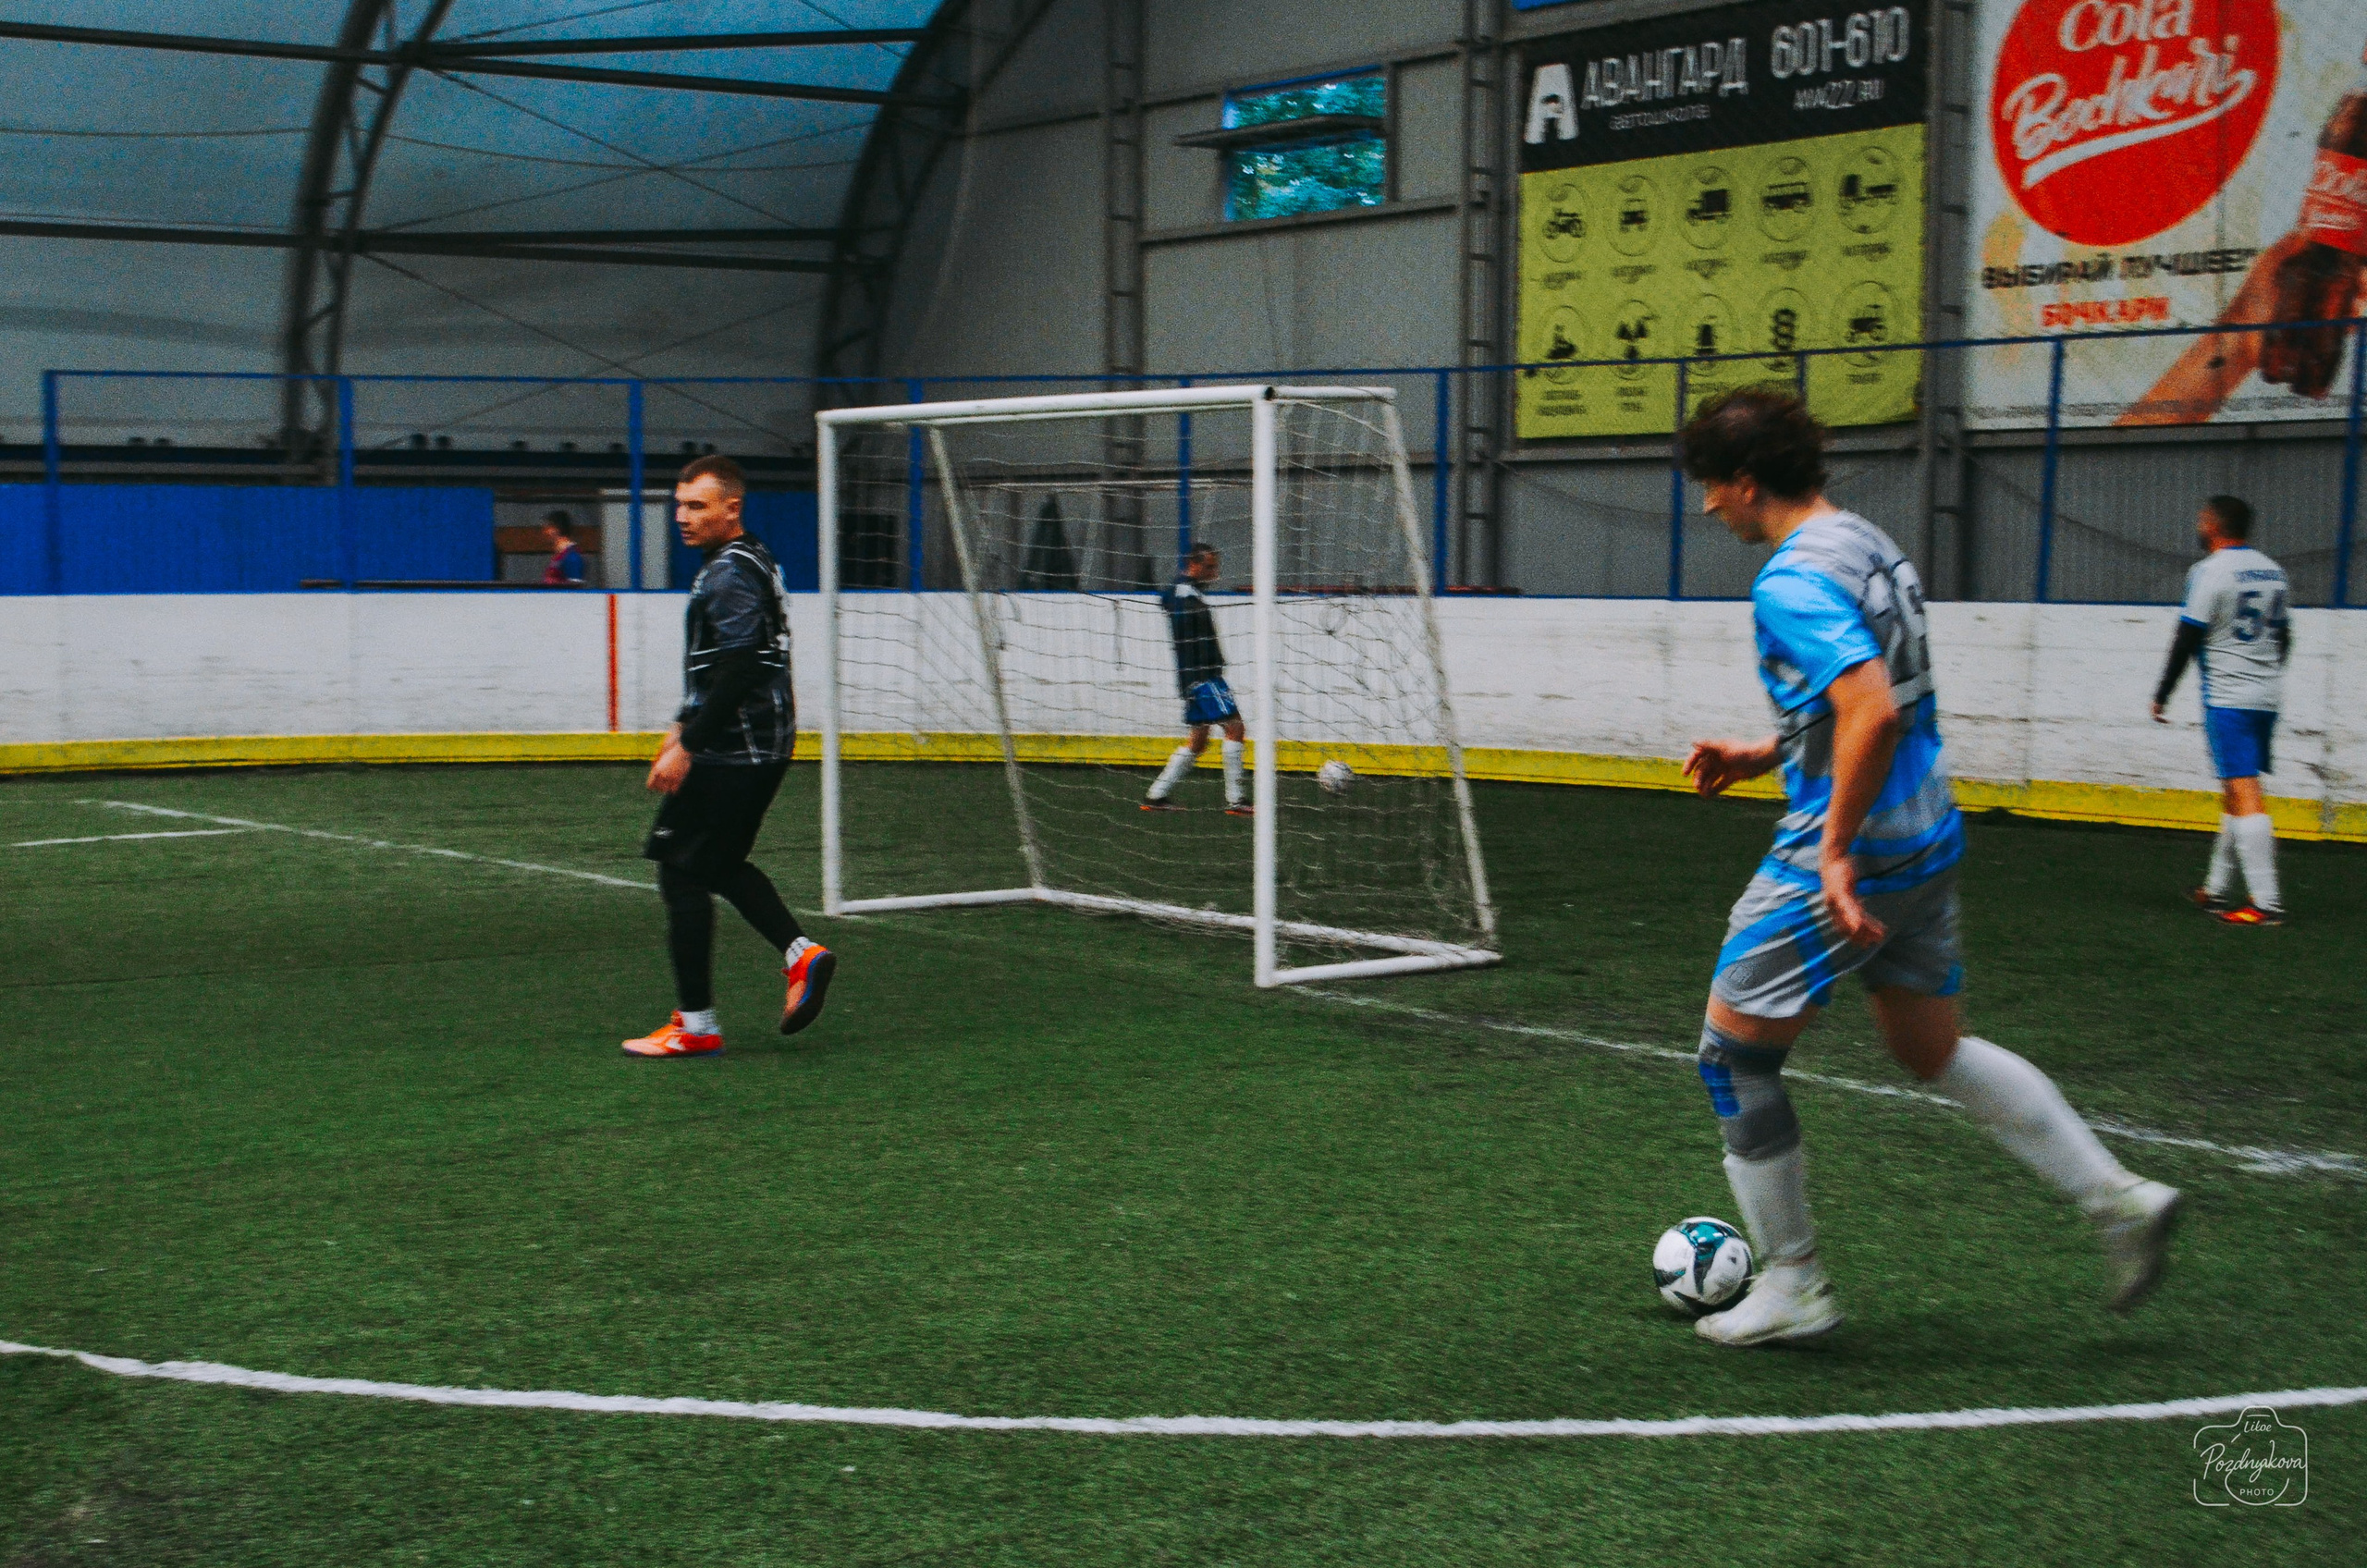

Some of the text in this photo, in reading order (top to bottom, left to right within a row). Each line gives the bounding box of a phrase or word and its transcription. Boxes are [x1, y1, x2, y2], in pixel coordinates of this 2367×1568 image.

[2058, 0, 2193, 52] Cola
[1579, 6, 1910, 109] АВАНГАРД 601-610
[1981, 252, 2115, 289] ВЫБИРАЙ
